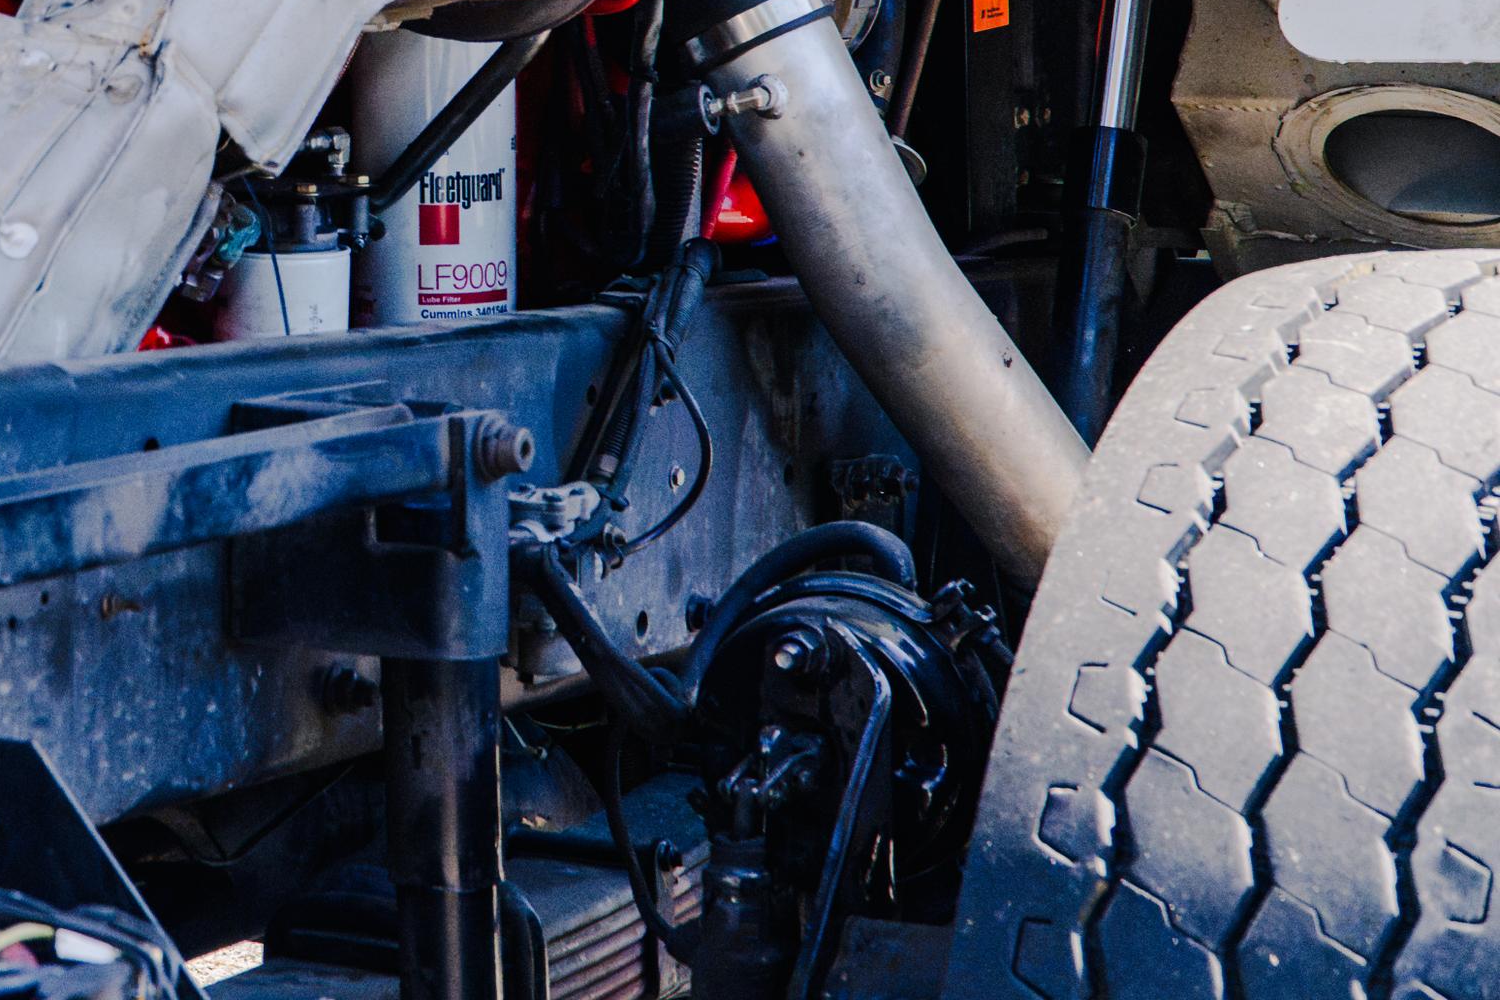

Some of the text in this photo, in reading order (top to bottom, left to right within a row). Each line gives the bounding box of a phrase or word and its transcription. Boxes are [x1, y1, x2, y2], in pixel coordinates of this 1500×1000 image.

[419, 168, 504, 209] Fleetguard
[418, 260, 507, 291] LF9009
[443, 295, 461, 303] Filter
[420, 309, 473, 320] Cummins
